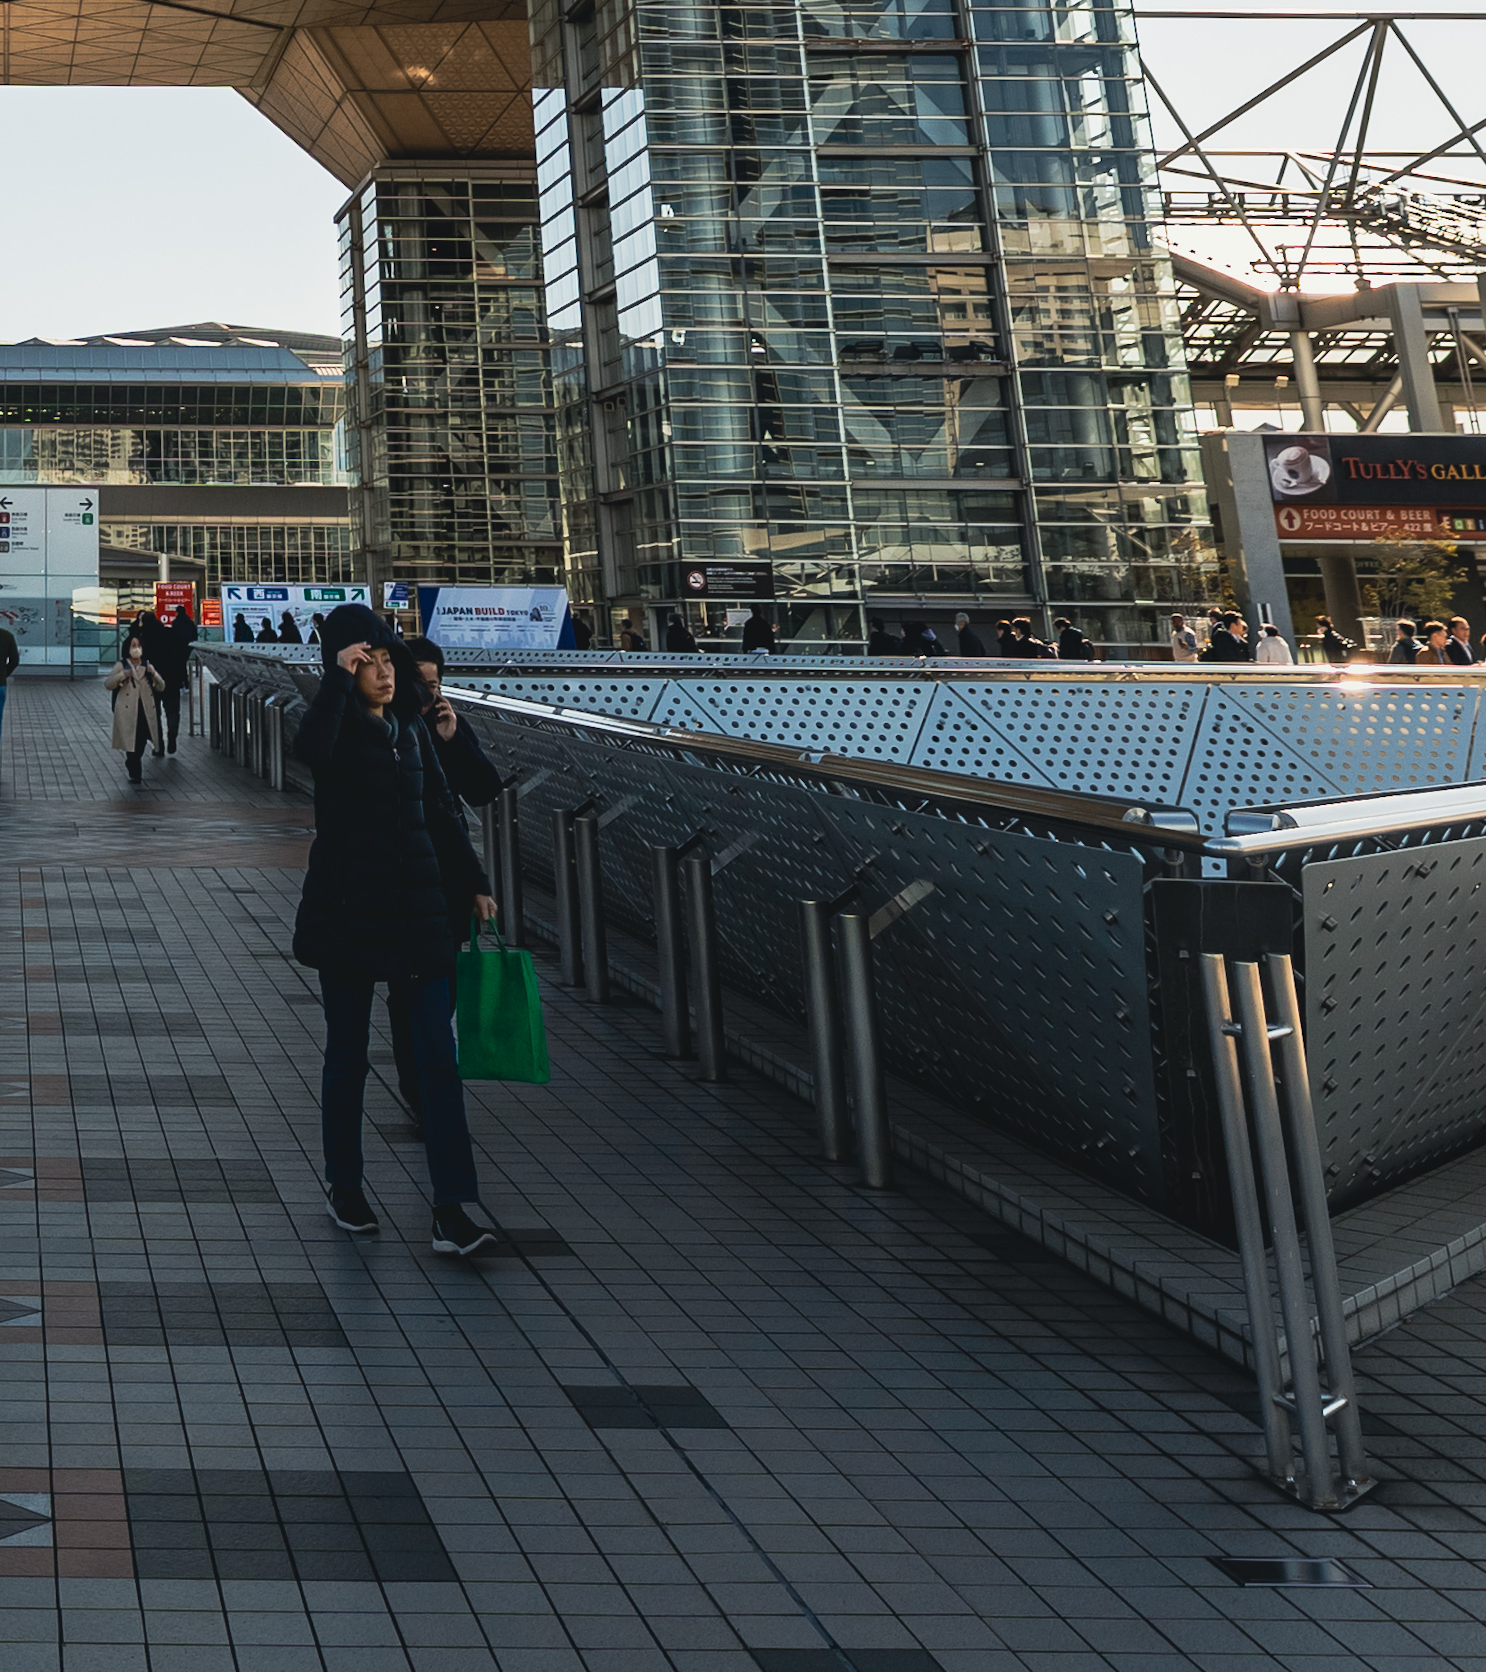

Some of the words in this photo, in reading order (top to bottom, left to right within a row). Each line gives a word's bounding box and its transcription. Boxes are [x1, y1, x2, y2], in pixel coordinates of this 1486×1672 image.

[1303, 509, 1337, 520] FOOD
[1340, 509, 1381, 520] COURT
[1386, 510, 1395, 520] &
[1400, 510, 1431, 520] BEER
[1304, 522, 1398, 531] フードコート&ビアー
[441, 607, 473, 615] JAPAN
[474, 607, 505, 615] BUILD
